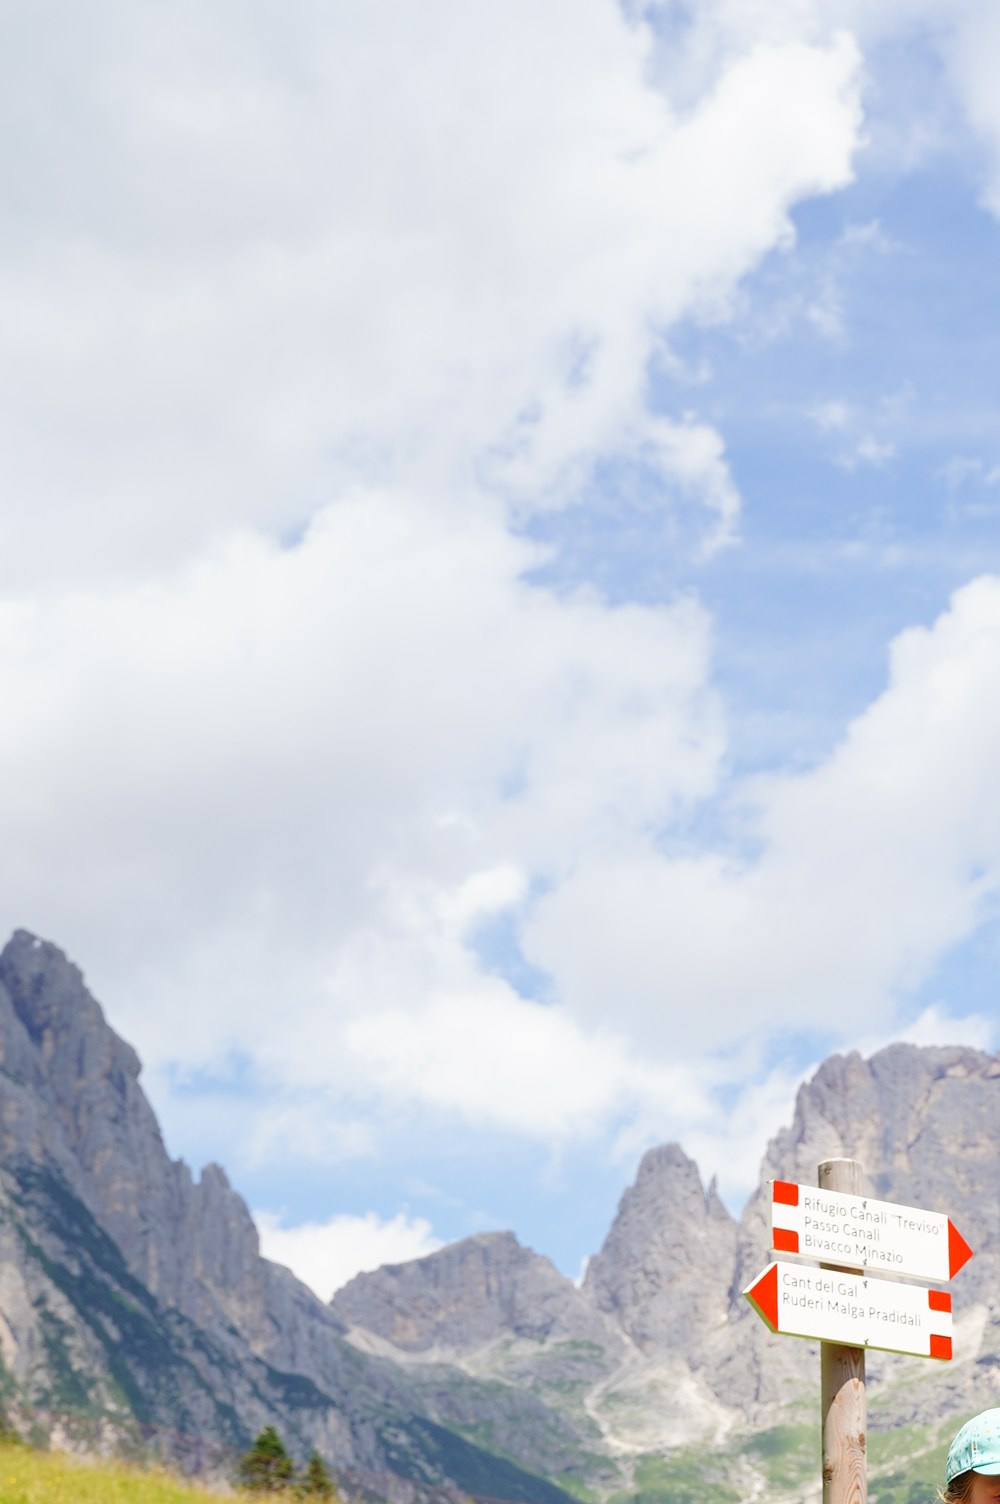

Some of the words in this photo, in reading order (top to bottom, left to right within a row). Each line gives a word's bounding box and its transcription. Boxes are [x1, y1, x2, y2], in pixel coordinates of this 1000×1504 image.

[804, 1197, 847, 1217] Rifugio
[850, 1206, 887, 1225] Canali
[891, 1213, 944, 1235] "Treviso"
[804, 1216, 839, 1233] Passo
[843, 1223, 880, 1241] Canali
[805, 1234, 852, 1254] Bivacco
[855, 1244, 904, 1264] Minazio
[782, 1273, 811, 1290] Cant
[815, 1279, 834, 1293] del
[837, 1283, 858, 1298] Gal
[782, 1292, 823, 1310] Ruderi
[827, 1300, 865, 1319] Malga
[868, 1306, 921, 1327] Pradidali
